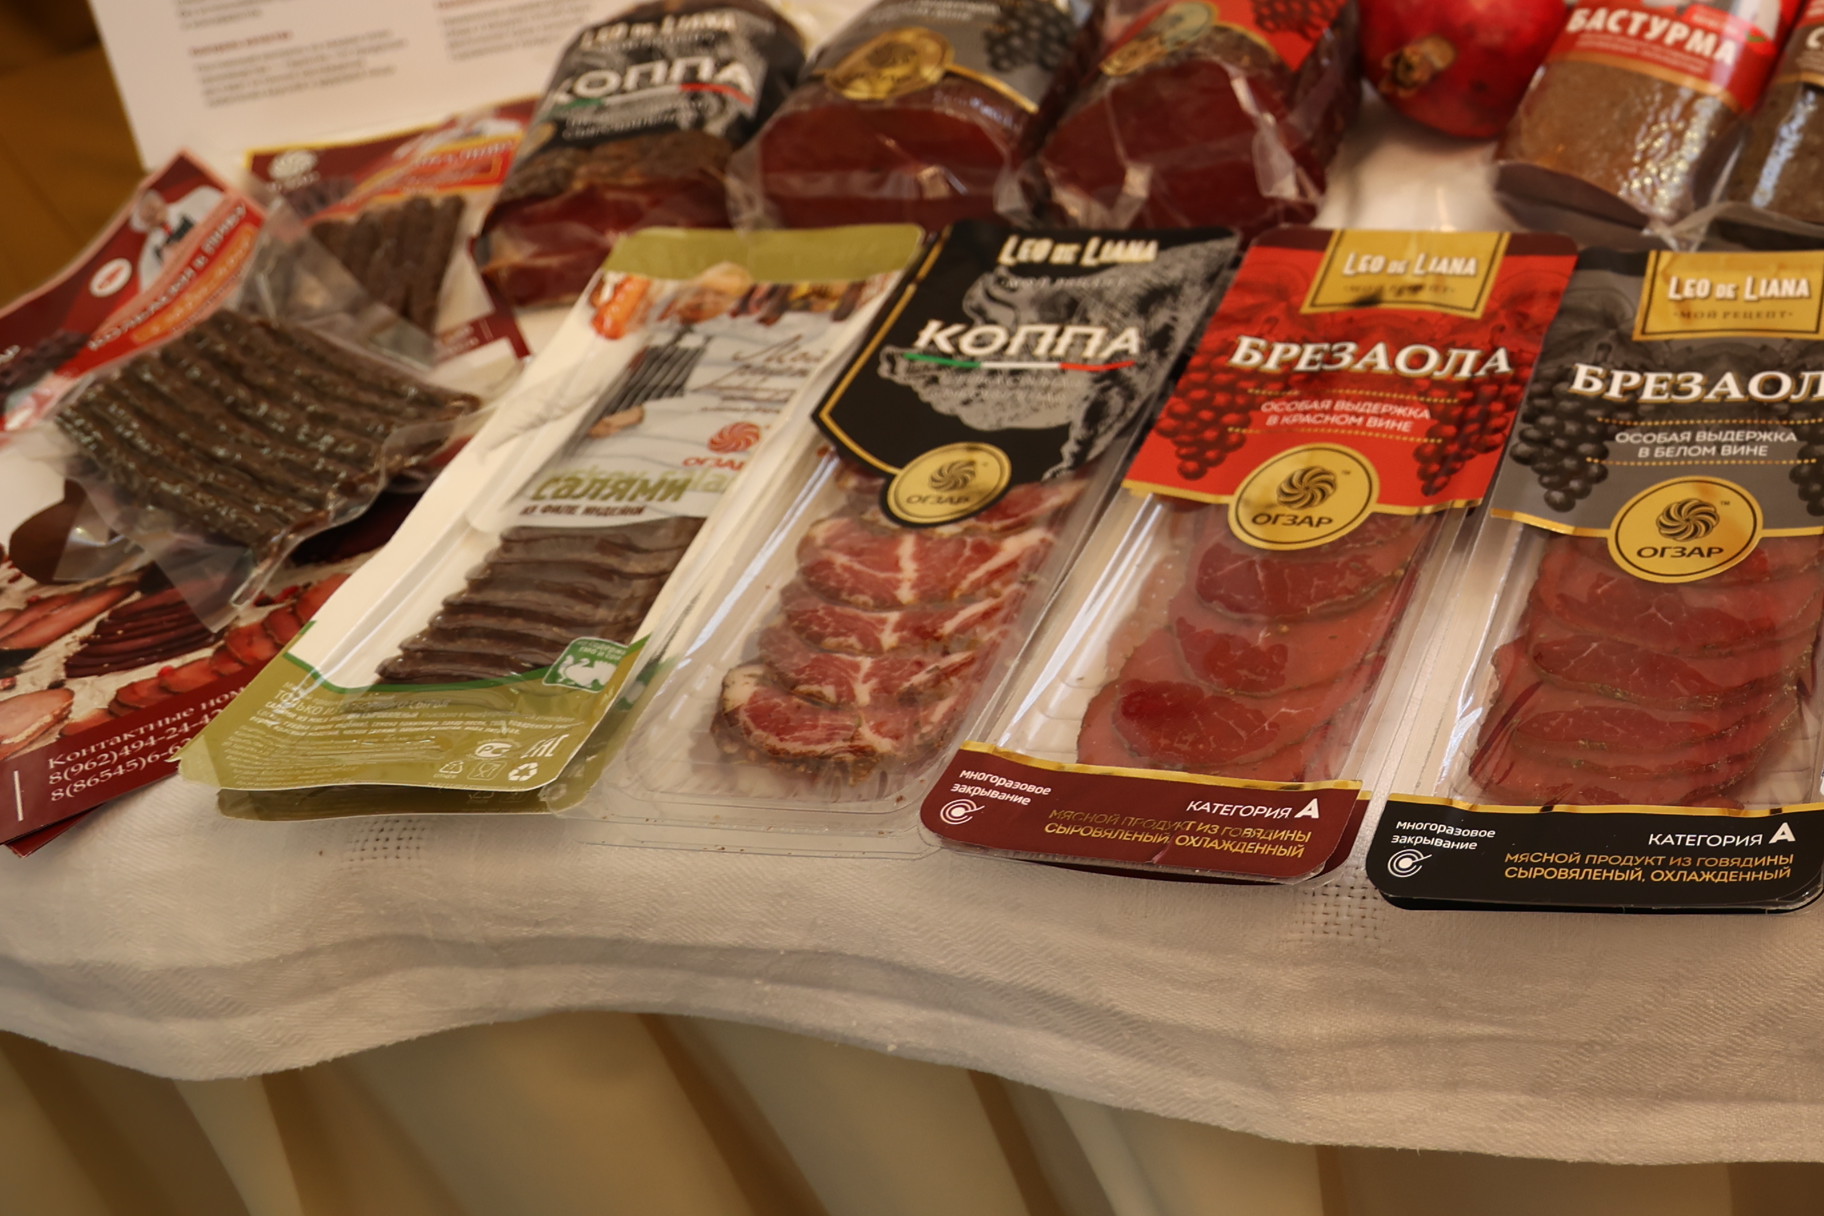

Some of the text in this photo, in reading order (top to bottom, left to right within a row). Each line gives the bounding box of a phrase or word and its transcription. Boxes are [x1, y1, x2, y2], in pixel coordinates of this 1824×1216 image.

[1565, 7, 1740, 66] БАСТУРМА
[998, 234, 1049, 266] LEO
[1080, 236, 1160, 266] LIANA
[1342, 251, 1384, 277] LEO
[1412, 252, 1479, 278] LIANA
[1667, 274, 1811, 302] LEO DE LIANA
[912, 318, 1142, 359] КОППА
[1227, 334, 1515, 381] БРЕЗАОЛА
[1260, 400, 1432, 421] ОСОБАЯ ВЫДЕРЖКА
[1265, 413, 1416, 433] В КРАСНОМ ВИНЕ
[1614, 430, 1798, 445] ОСОБАЯ ВЫДЕРЖКА
[1637, 444, 1769, 459] В БЕЛОМ ВИНЕ
[1250, 513, 1335, 529] ОГЗАР
[1635, 545, 1725, 560] ОГЗАР
[48, 706, 196, 770] Контактные
[950, 782, 1032, 807] закрывание
[958, 768, 1052, 798] многоразовое
[1185, 797, 1321, 820] КАТЕГОРИЯ А
[1048, 808, 1312, 844] МЯСНОЙ ПРОДУКТ ИЗ ГОВЯДИНЫ
[1395, 820, 1496, 839] многоразовое
[1647, 821, 1796, 847] КАТЕГОРИЯ А
[1174, 834, 1305, 859] ОХЛАЖДЕННЫЙ
[1390, 833, 1478, 852] закрывание
[1504, 850, 1795, 870] МЯСНОЙ ПРОДУКТ ИЗ ГОВЯДИНЫ
[1503, 864, 1793, 884] СЫРОВЯЛЕНЫЙ, ОХЛАЖДЕННЫЙ
